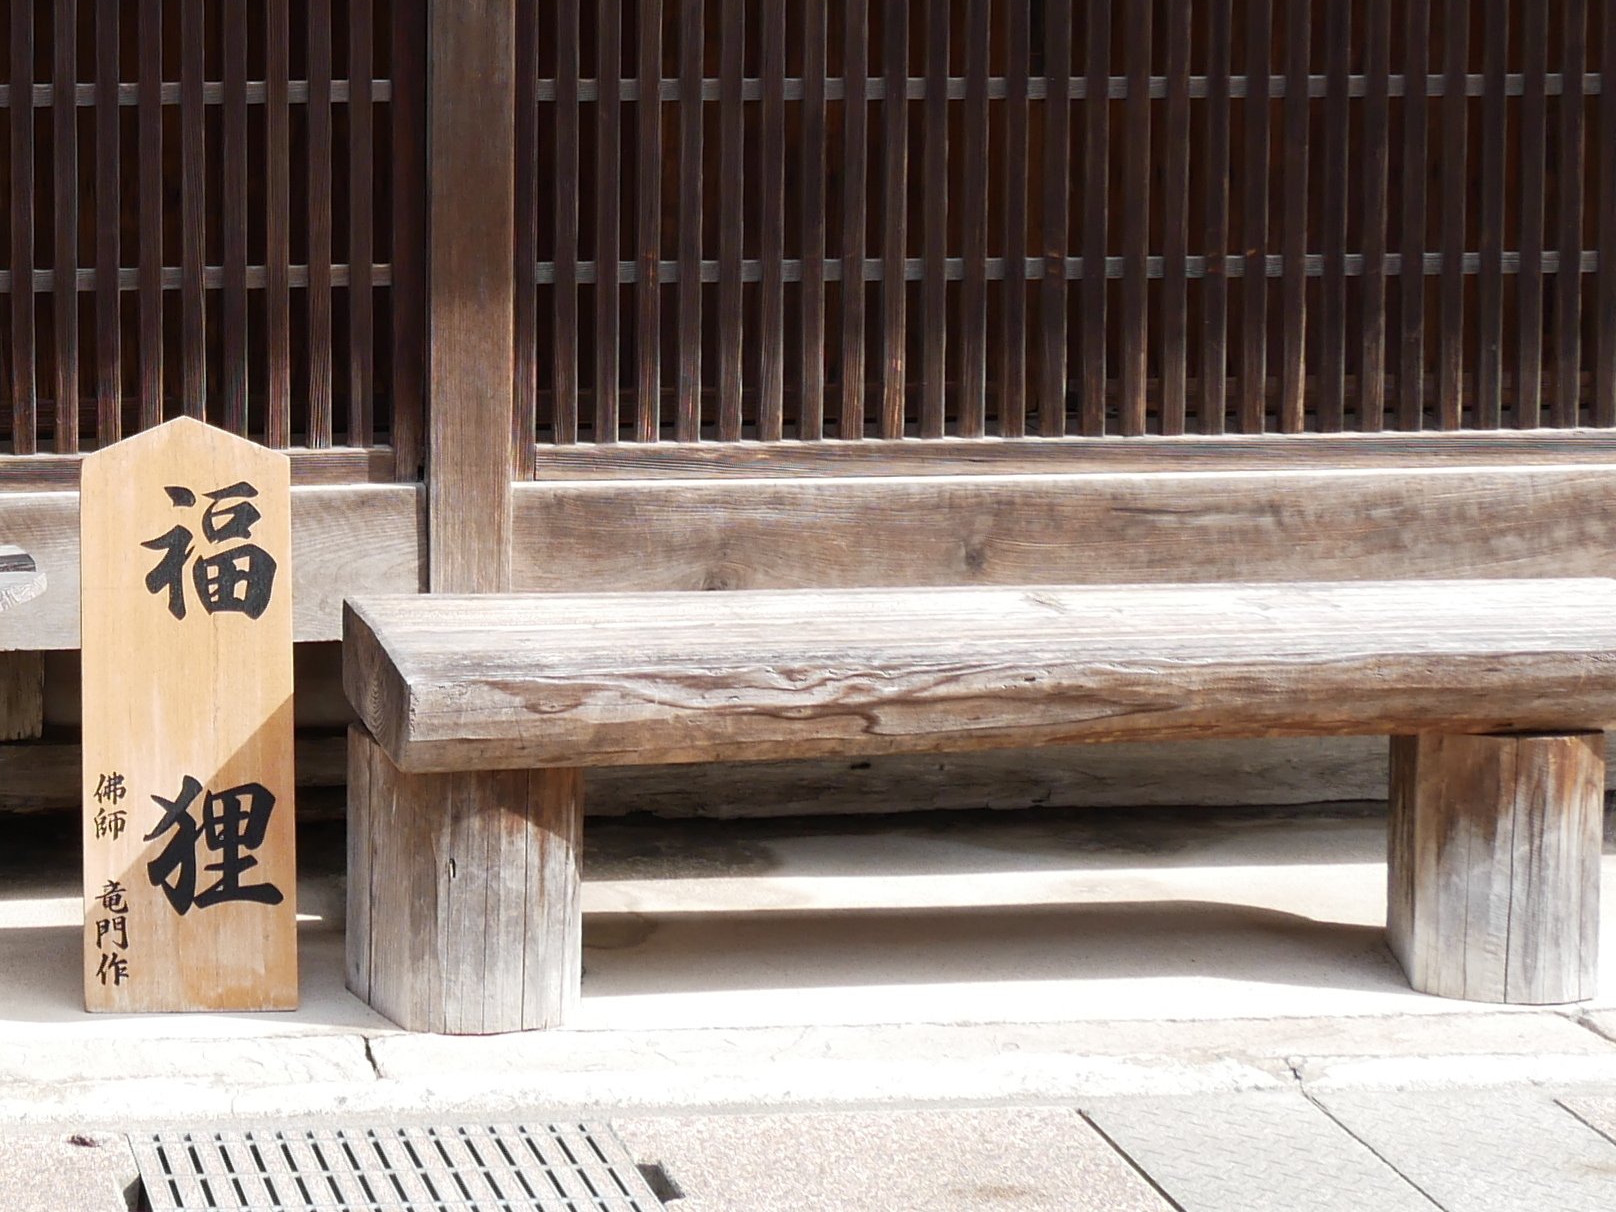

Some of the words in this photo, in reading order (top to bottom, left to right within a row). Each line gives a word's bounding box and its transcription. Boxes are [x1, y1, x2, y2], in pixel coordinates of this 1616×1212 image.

[140, 481, 284, 916] 福狸
[92, 772, 126, 841] 佛師
[94, 879, 129, 987] 竜門作
